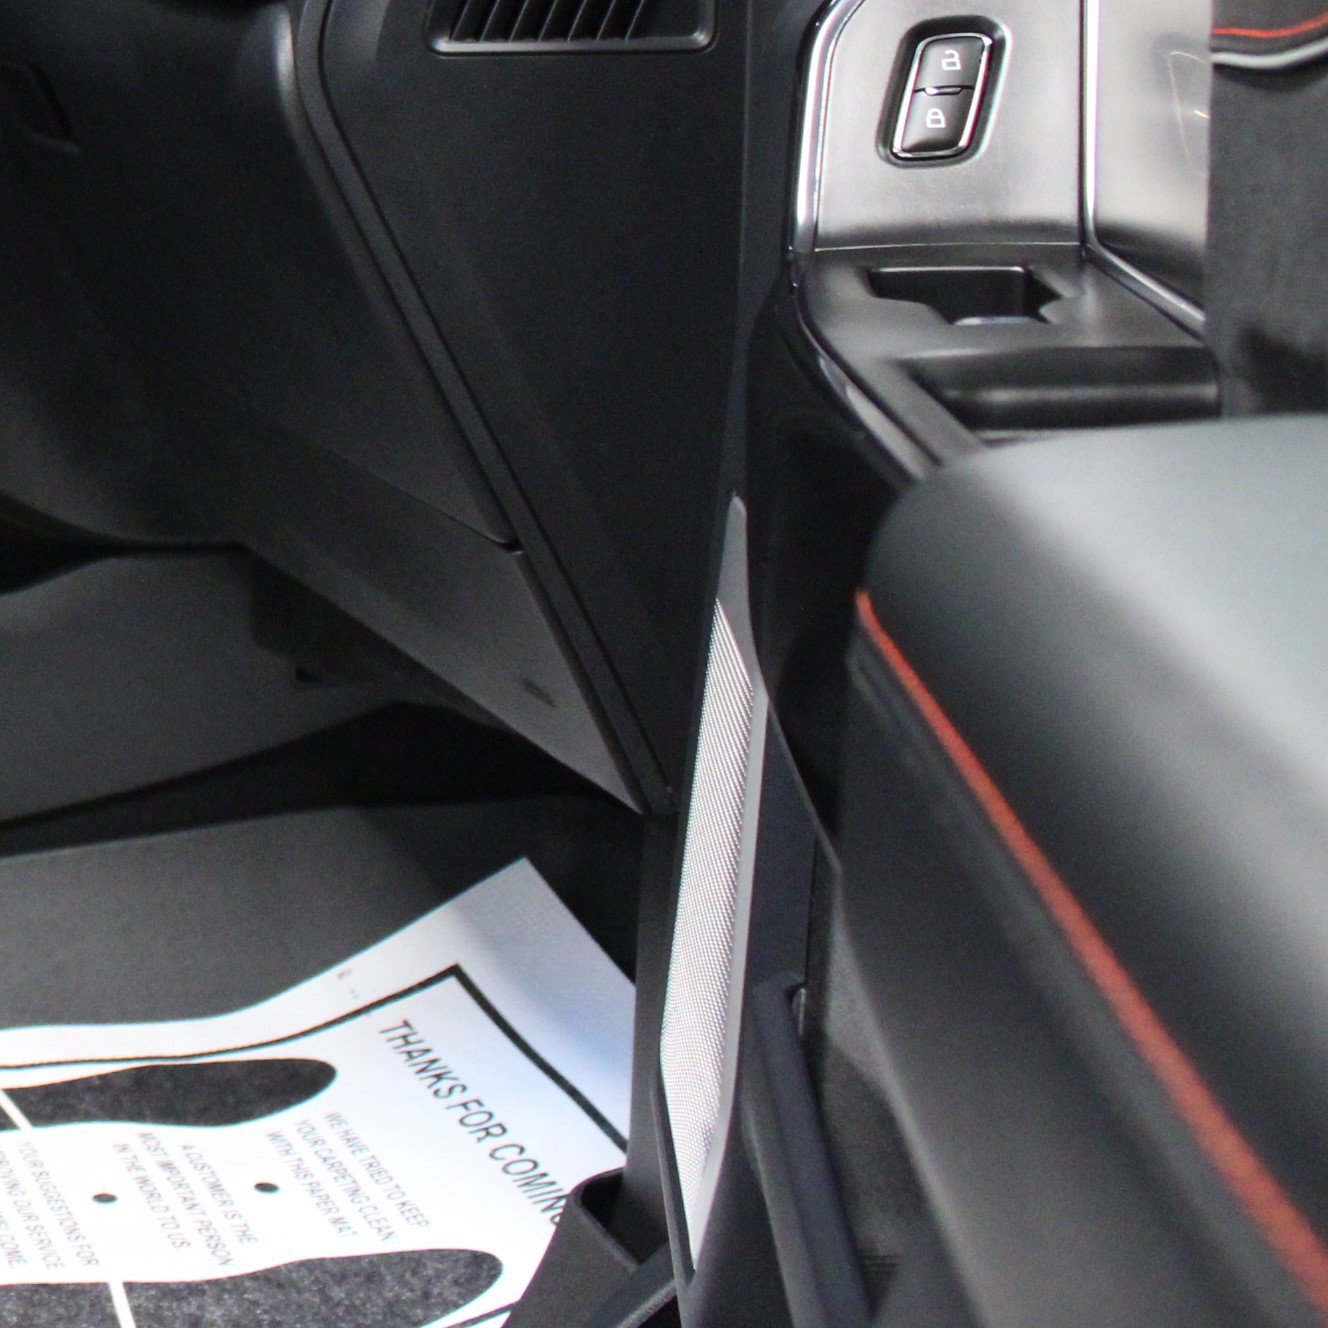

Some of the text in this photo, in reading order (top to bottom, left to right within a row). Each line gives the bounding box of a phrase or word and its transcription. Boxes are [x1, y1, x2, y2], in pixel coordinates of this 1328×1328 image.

[379, 1019, 468, 1099] THANKS
[445, 1098, 508, 1143] FOR
[112, 1143, 129, 1153] IN
[122, 1154, 145, 1173] THE
[324, 1111, 430, 1228] WE HAVE TRIED TO KEEP
[133, 1175, 170, 1214] WORLD
[137, 1132, 236, 1266] MOST IMPORTANT PERSON
[185, 1152, 234, 1207] CUSTOMER
[265, 1130, 360, 1239] WITH THIS PAPER MAT
[293, 1119, 400, 1242] YOUR CARPETING CLEAN
[13, 1200, 39, 1222] OUR
[17, 1141, 100, 1267] YOUR SUGGESTIONS FOR
[157, 1215, 180, 1231] TO
[223, 1210, 243, 1221] IS
[25, 1224, 65, 1270] SERVICE
[230, 1223, 258, 1244] THE
